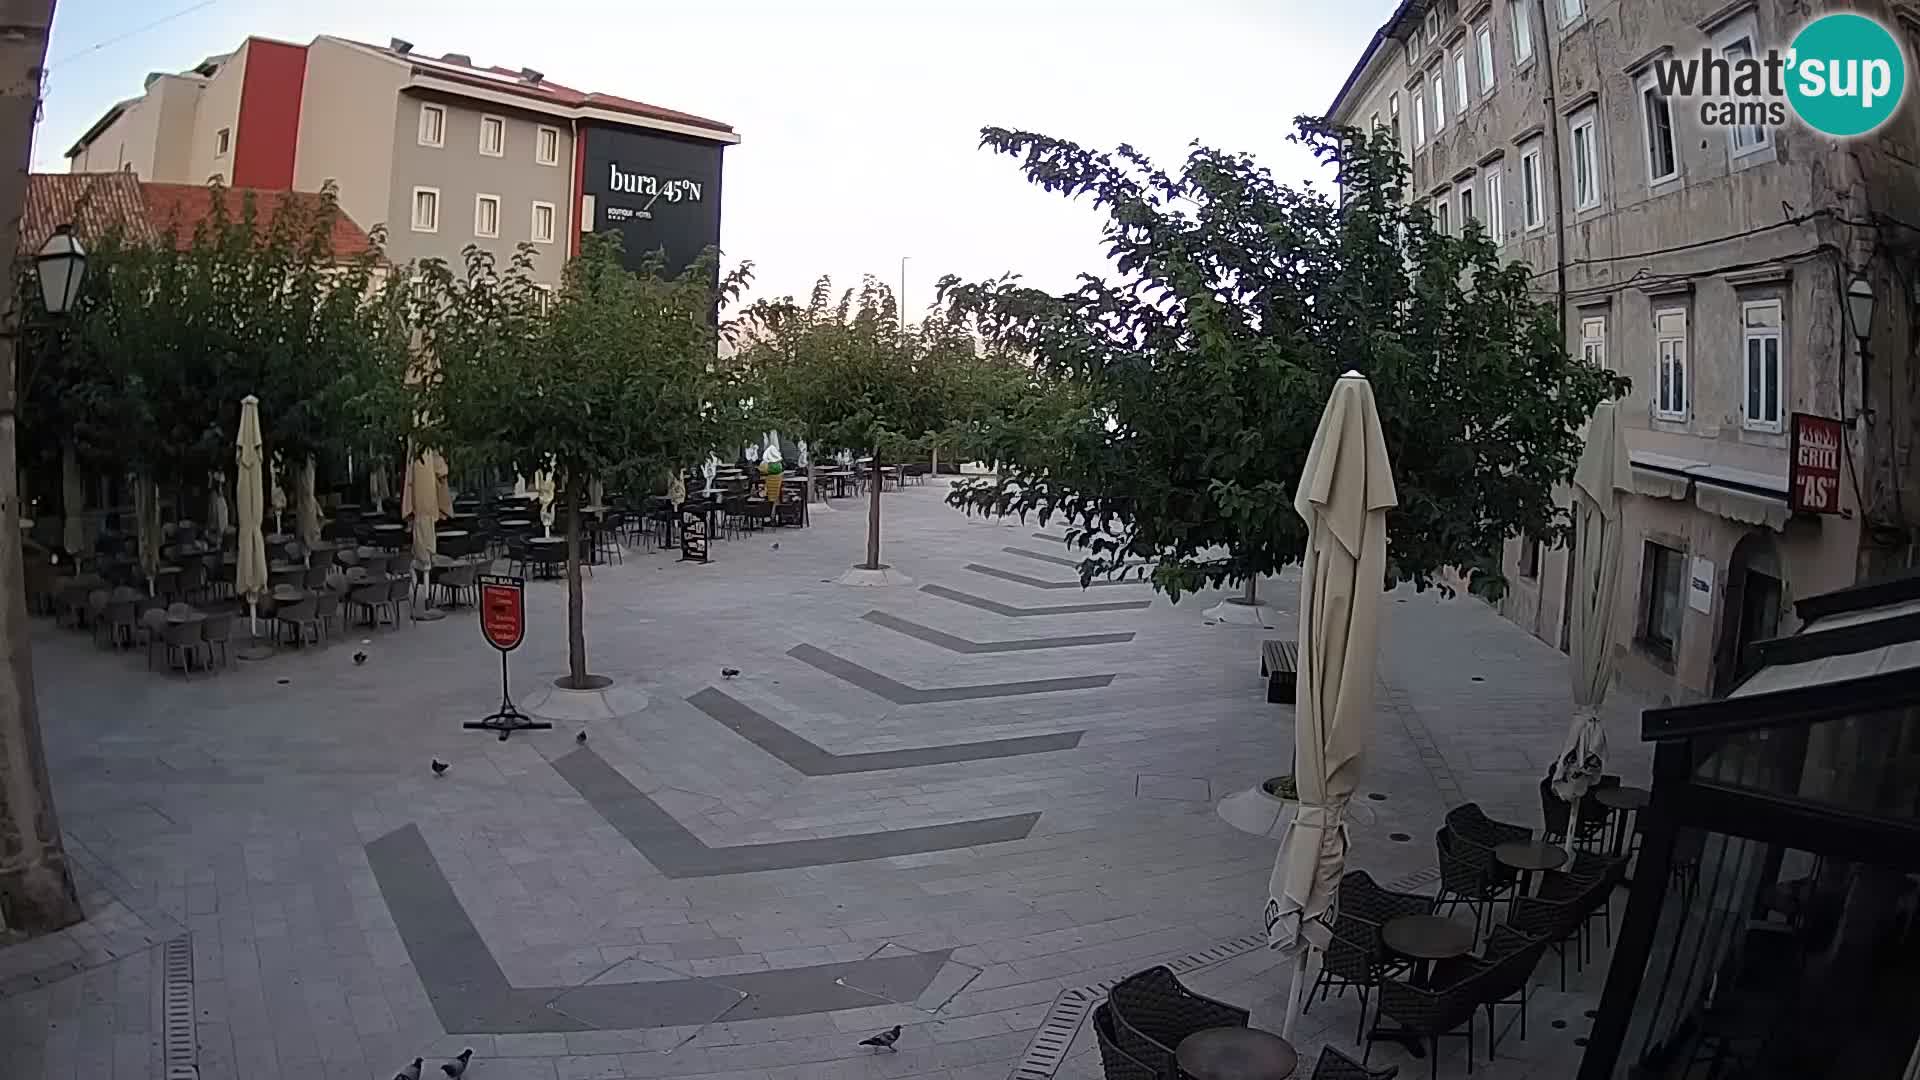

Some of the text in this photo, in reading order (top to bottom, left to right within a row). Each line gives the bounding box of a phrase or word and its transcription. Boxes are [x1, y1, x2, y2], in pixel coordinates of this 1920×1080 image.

[610, 164, 657, 196] bura
[607, 207, 652, 220] BOUTIQUE HOTEL
[1798, 446, 1838, 471] GRILL
[498, 577, 513, 585] BAR
